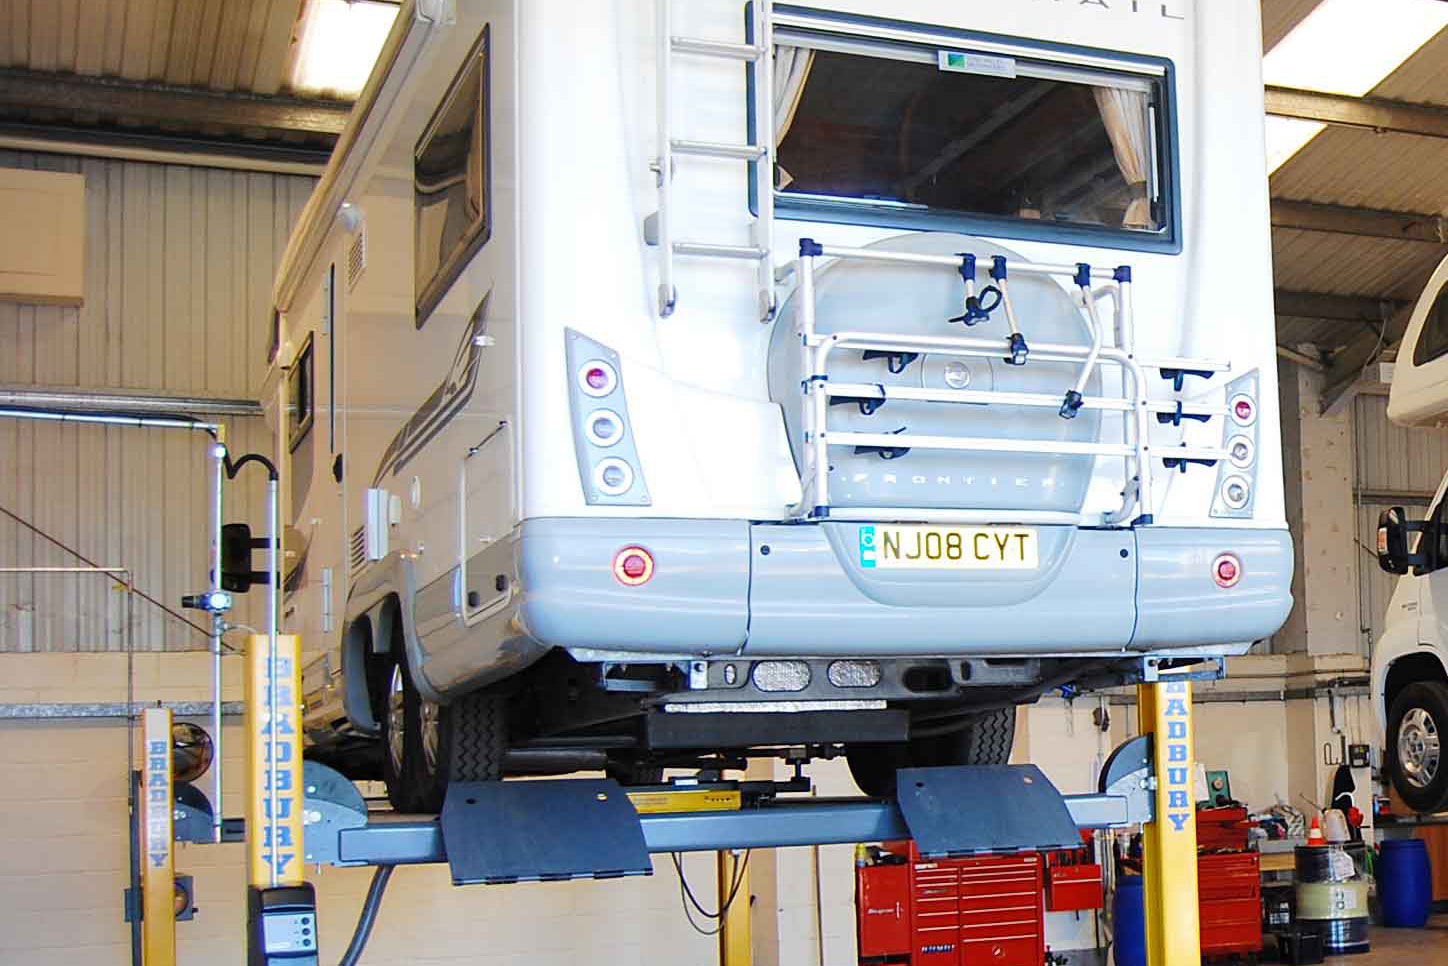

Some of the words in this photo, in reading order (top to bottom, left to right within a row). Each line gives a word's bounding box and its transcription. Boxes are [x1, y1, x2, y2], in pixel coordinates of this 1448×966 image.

[883, 531, 963, 560] NJ08
[974, 533, 1030, 561] CYT
[261, 656, 294, 876] BRADBURY
